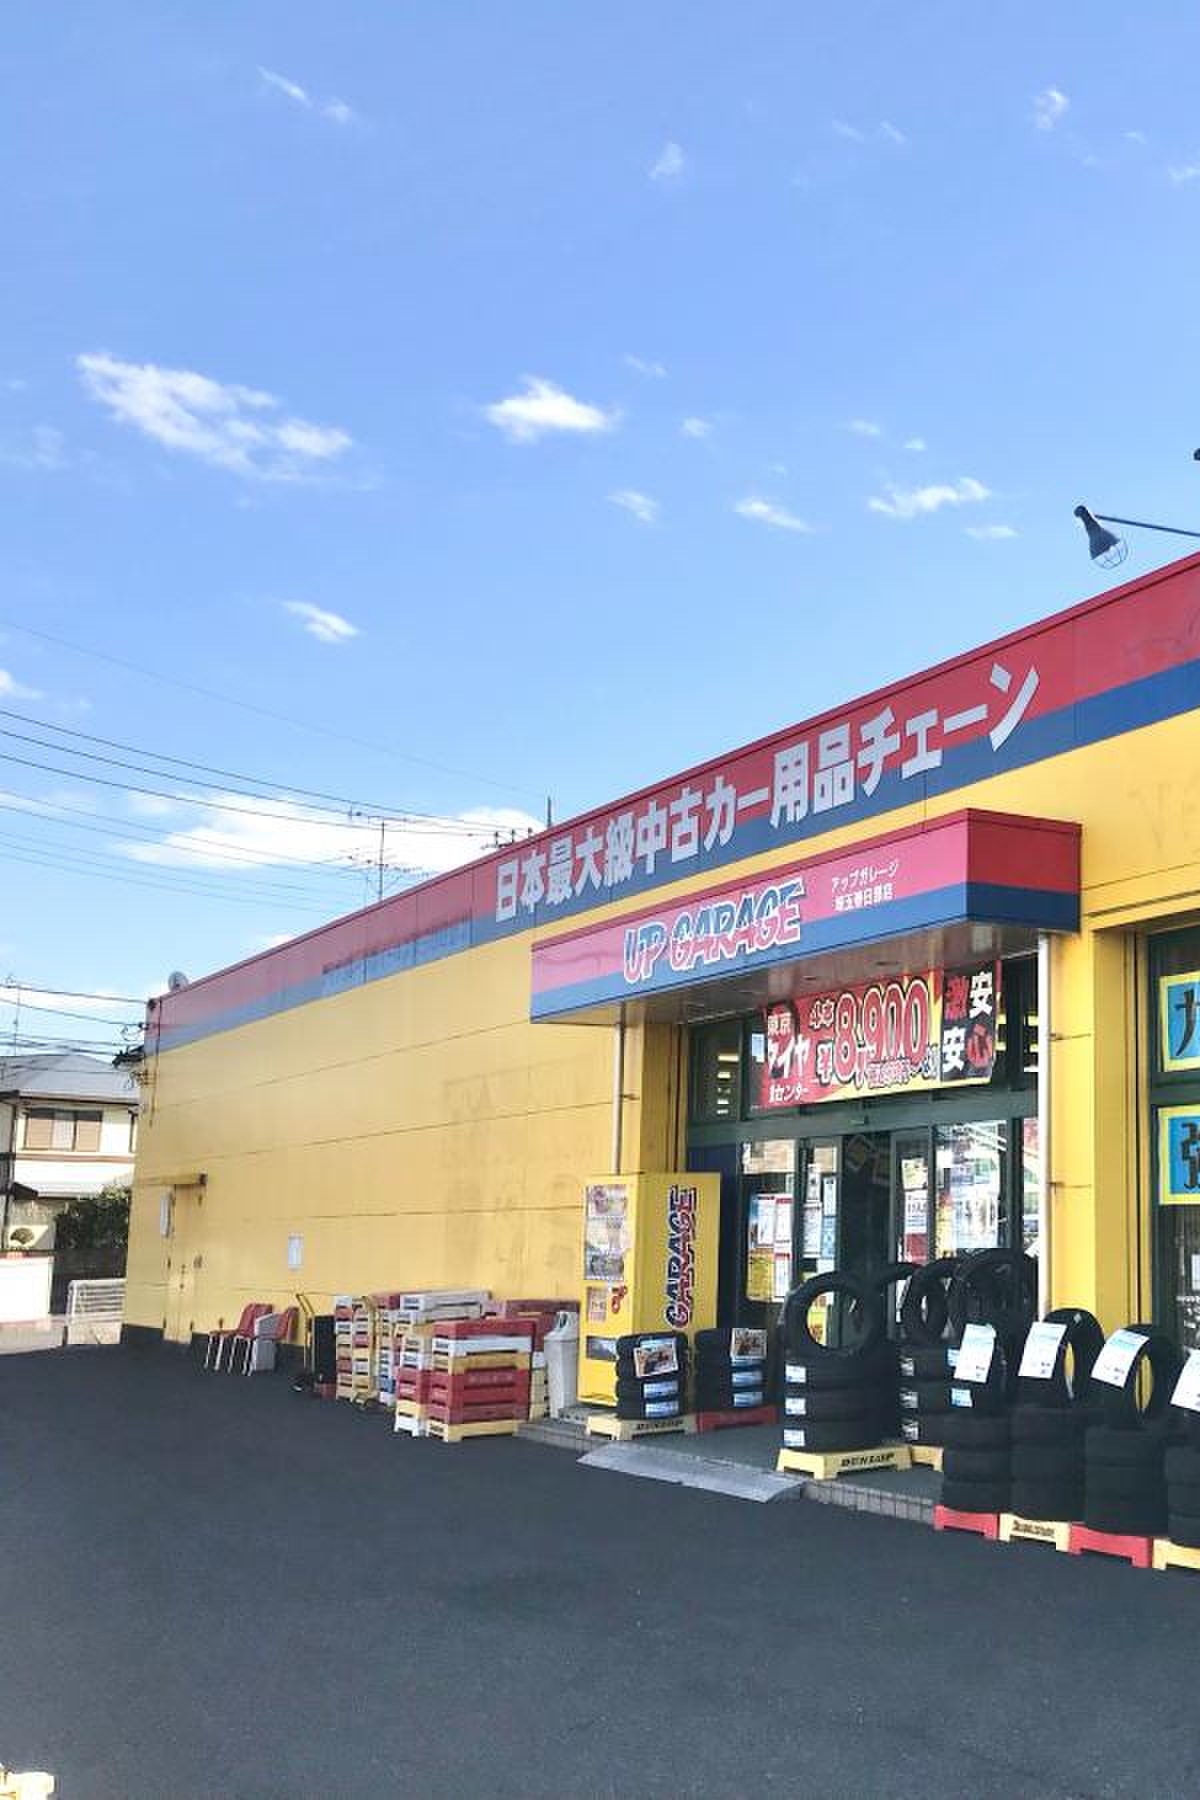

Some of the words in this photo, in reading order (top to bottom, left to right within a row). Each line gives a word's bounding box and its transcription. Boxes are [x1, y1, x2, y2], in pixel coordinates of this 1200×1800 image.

[495, 663, 1040, 923] 日本最大級中古カー用品チェーン
[623, 920, 668, 984] UP
[670, 877, 805, 972] GARAGE
